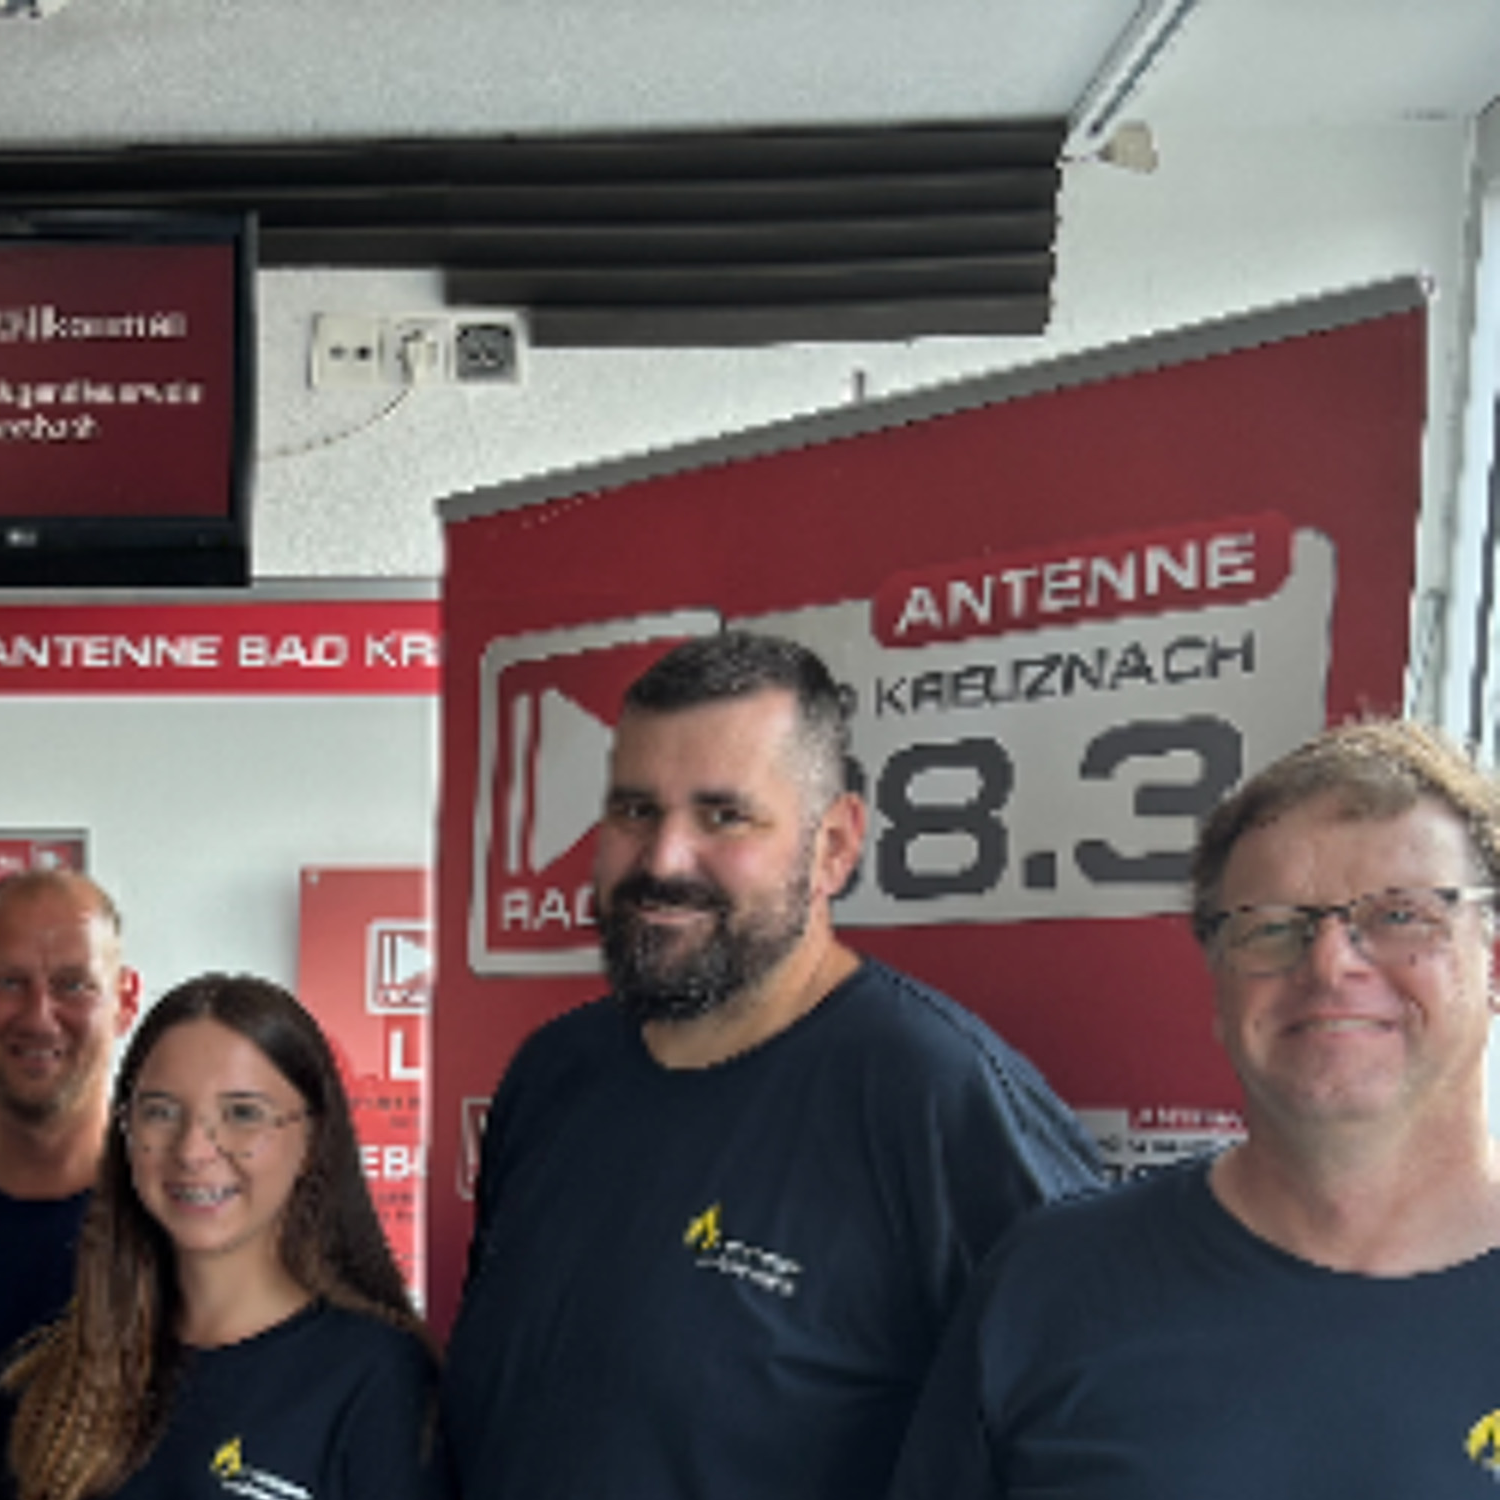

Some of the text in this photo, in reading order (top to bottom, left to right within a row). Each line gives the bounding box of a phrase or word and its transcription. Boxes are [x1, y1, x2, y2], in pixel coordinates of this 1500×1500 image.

[894, 532, 1257, 637] ANTENNE
[238, 634, 349, 669] BAD
[365, 630, 441, 668] KR
[875, 631, 1256, 718] KREUZNACH
